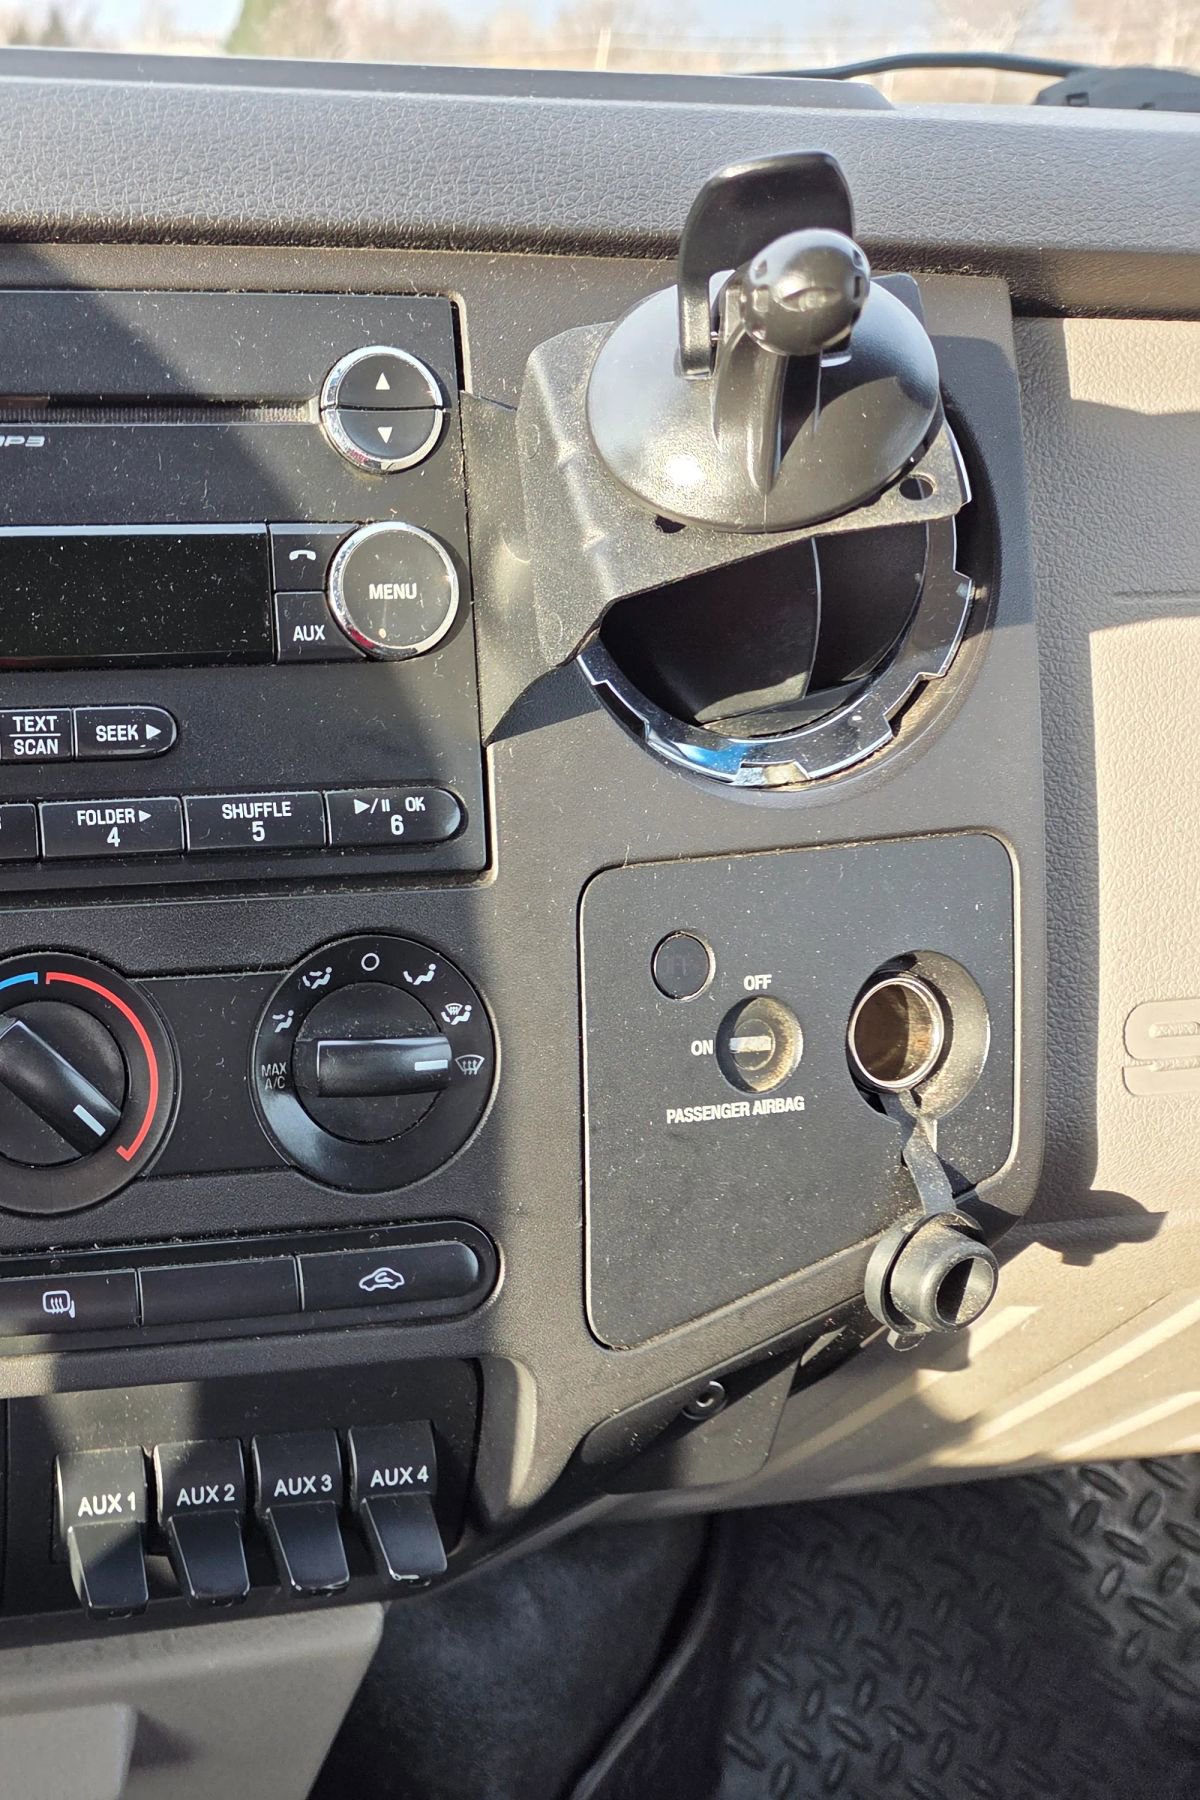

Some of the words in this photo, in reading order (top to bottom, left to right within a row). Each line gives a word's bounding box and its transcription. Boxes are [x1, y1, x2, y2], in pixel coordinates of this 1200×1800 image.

[368, 583, 418, 600] MENU
[292, 625, 326, 642] AUX
[11, 716, 58, 733] TEXT
[95, 725, 139, 742] SEEK
[13, 739, 59, 756] SCAN
[221, 801, 292, 820] SHUFFLE
[404, 797, 426, 812] OK
[76, 808, 136, 826] FOLDER
[390, 815, 405, 836] 6
[106, 827, 121, 848] 4
[251, 821, 266, 842] 5
[743, 974, 773, 991] OFF
[690, 1040, 714, 1057] ON
[262, 1062, 287, 1076] MAX
[265, 1076, 285, 1090] A/C
[666, 1102, 751, 1125] PASSENGER
[751, 1096, 806, 1116] AIRBAG
[370, 1467, 414, 1488] AUX
[416, 1465, 429, 1483] 4
[273, 1476, 317, 1497] AUX
[320, 1474, 333, 1492] 3
[176, 1485, 220, 1507] AUX
[223, 1484, 235, 1502] 2
[77, 1494, 123, 1518] AUX
[127, 1492, 136, 1512] 1
